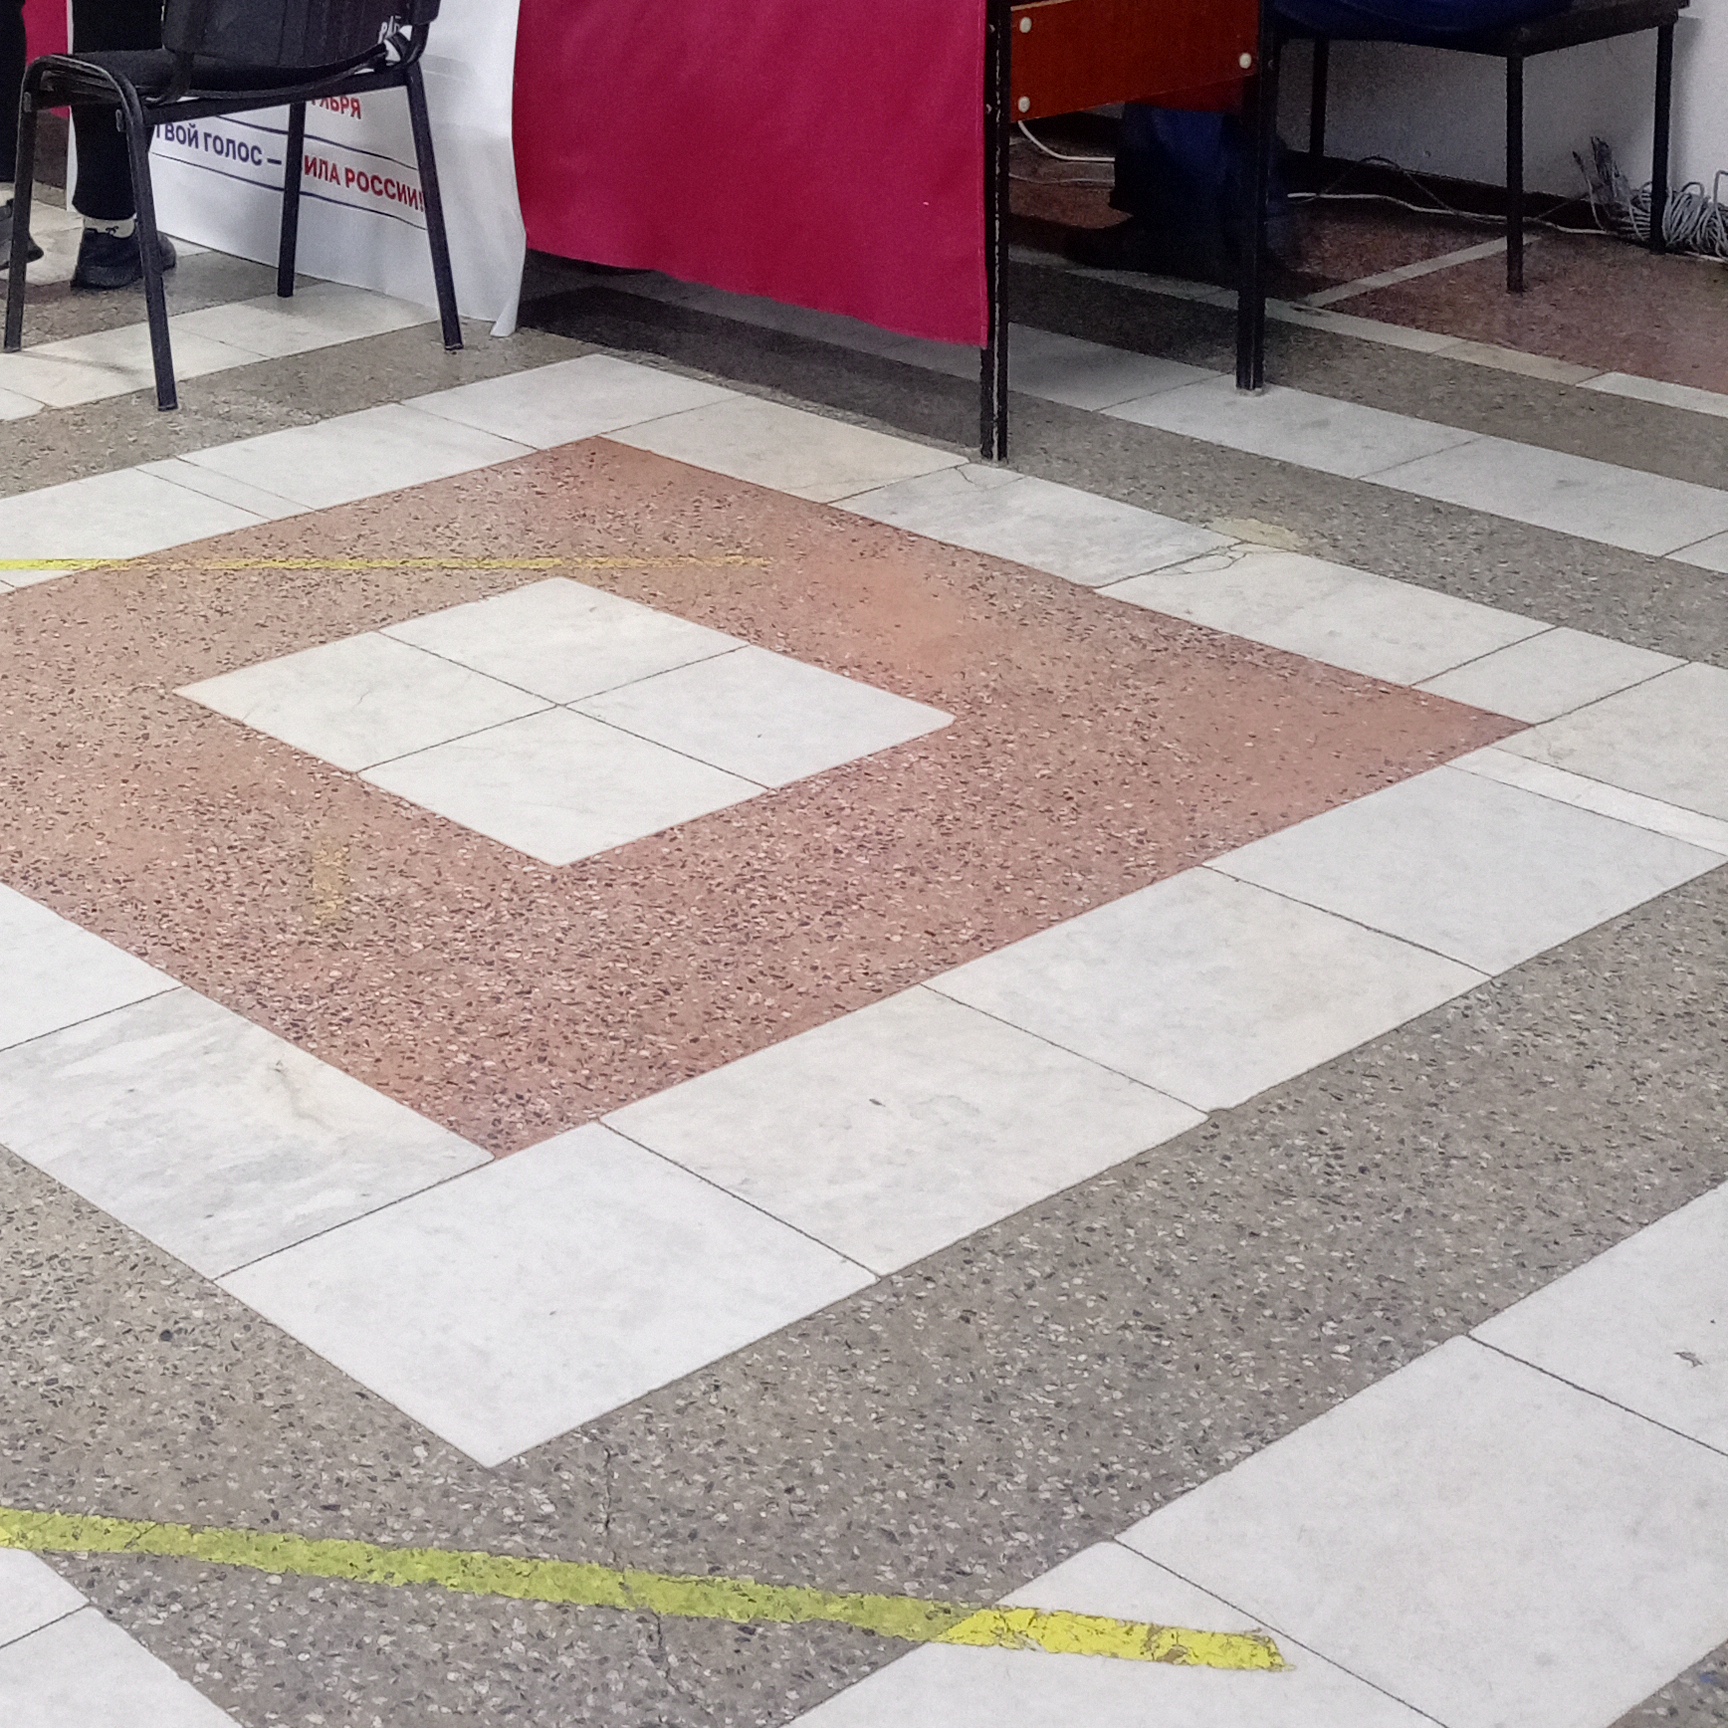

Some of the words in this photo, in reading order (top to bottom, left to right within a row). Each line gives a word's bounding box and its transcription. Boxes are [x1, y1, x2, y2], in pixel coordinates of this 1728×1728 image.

[203, 132, 262, 166] ГОЛОС
[304, 155, 340, 186] ИЛА
[345, 168, 424, 212] РОССИИ!
